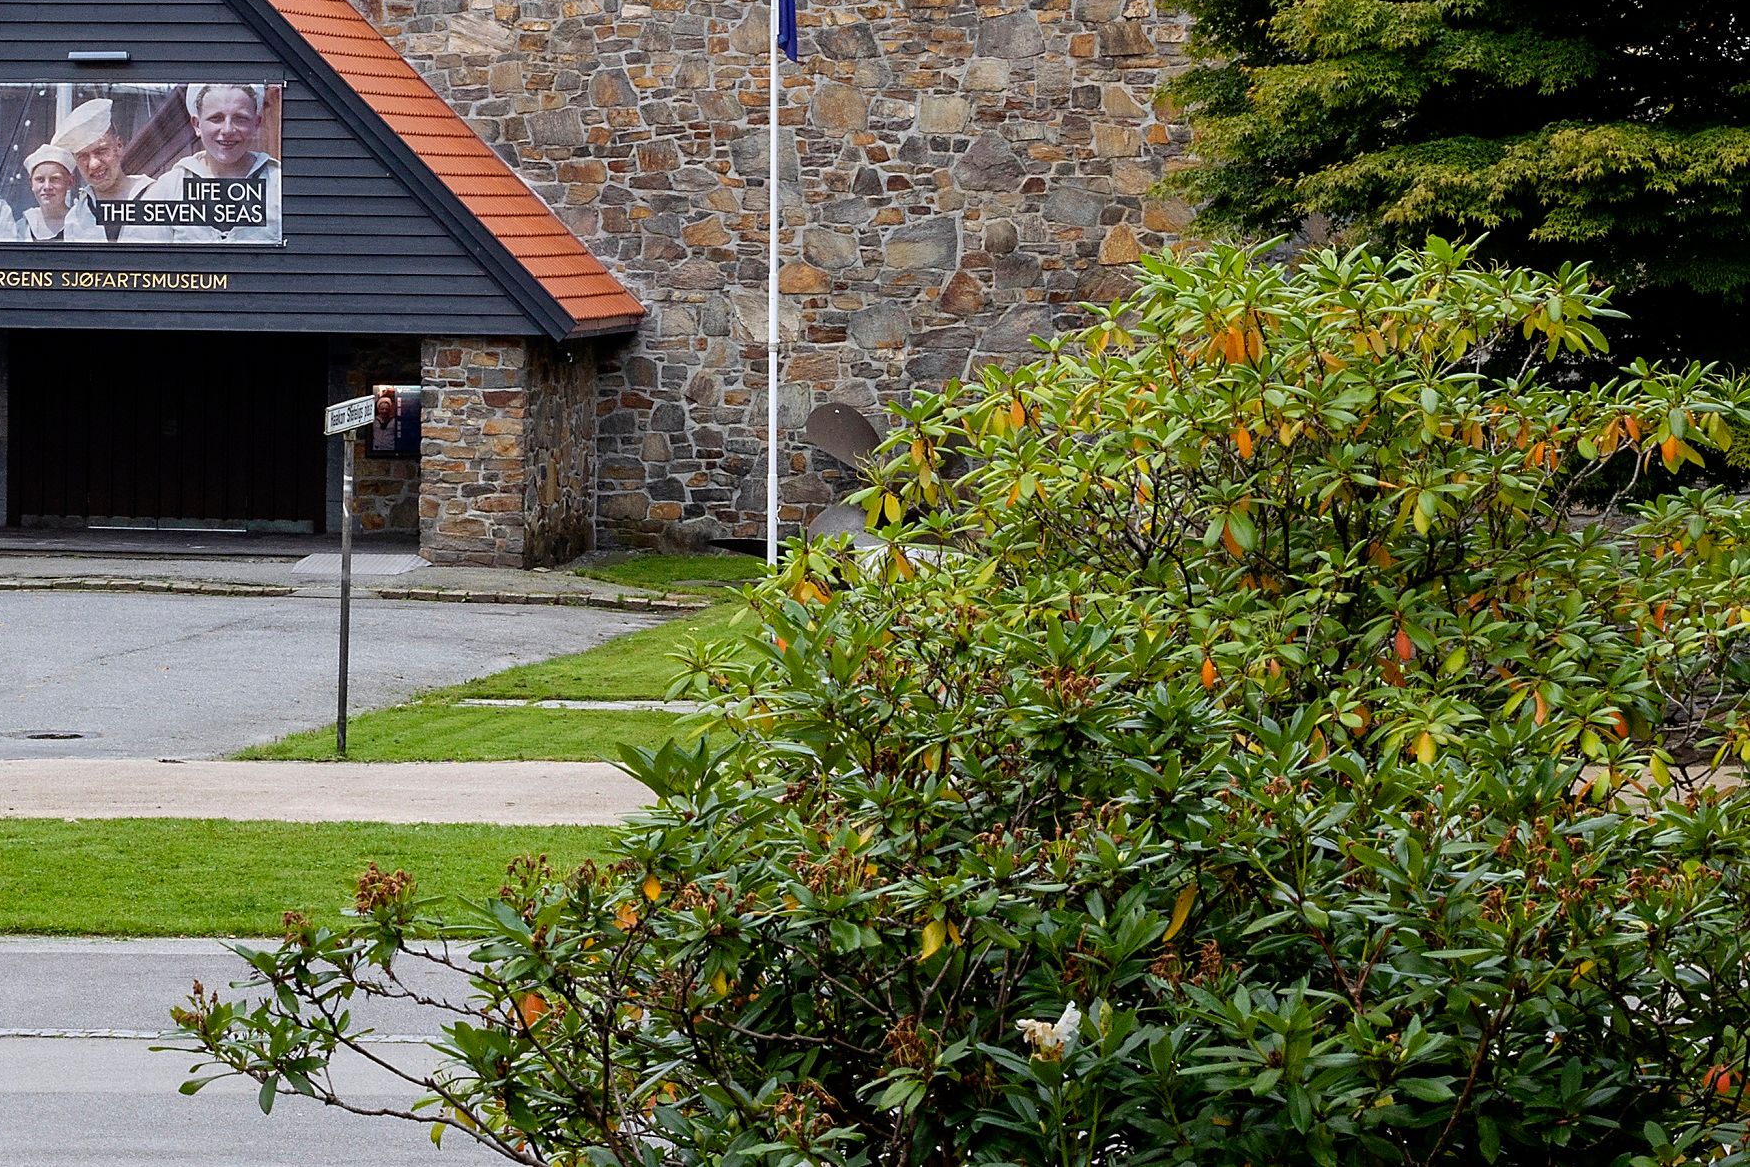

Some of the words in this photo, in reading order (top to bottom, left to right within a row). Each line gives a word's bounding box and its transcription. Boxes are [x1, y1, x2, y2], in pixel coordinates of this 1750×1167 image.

[188, 182, 221, 201] LIFE
[227, 182, 262, 201] ON
[100, 203, 136, 222] THE
[143, 203, 207, 222] SEVEN
[213, 204, 263, 223] SEAS
[61, 271, 228, 290] SJØFARTSMUSEUM
